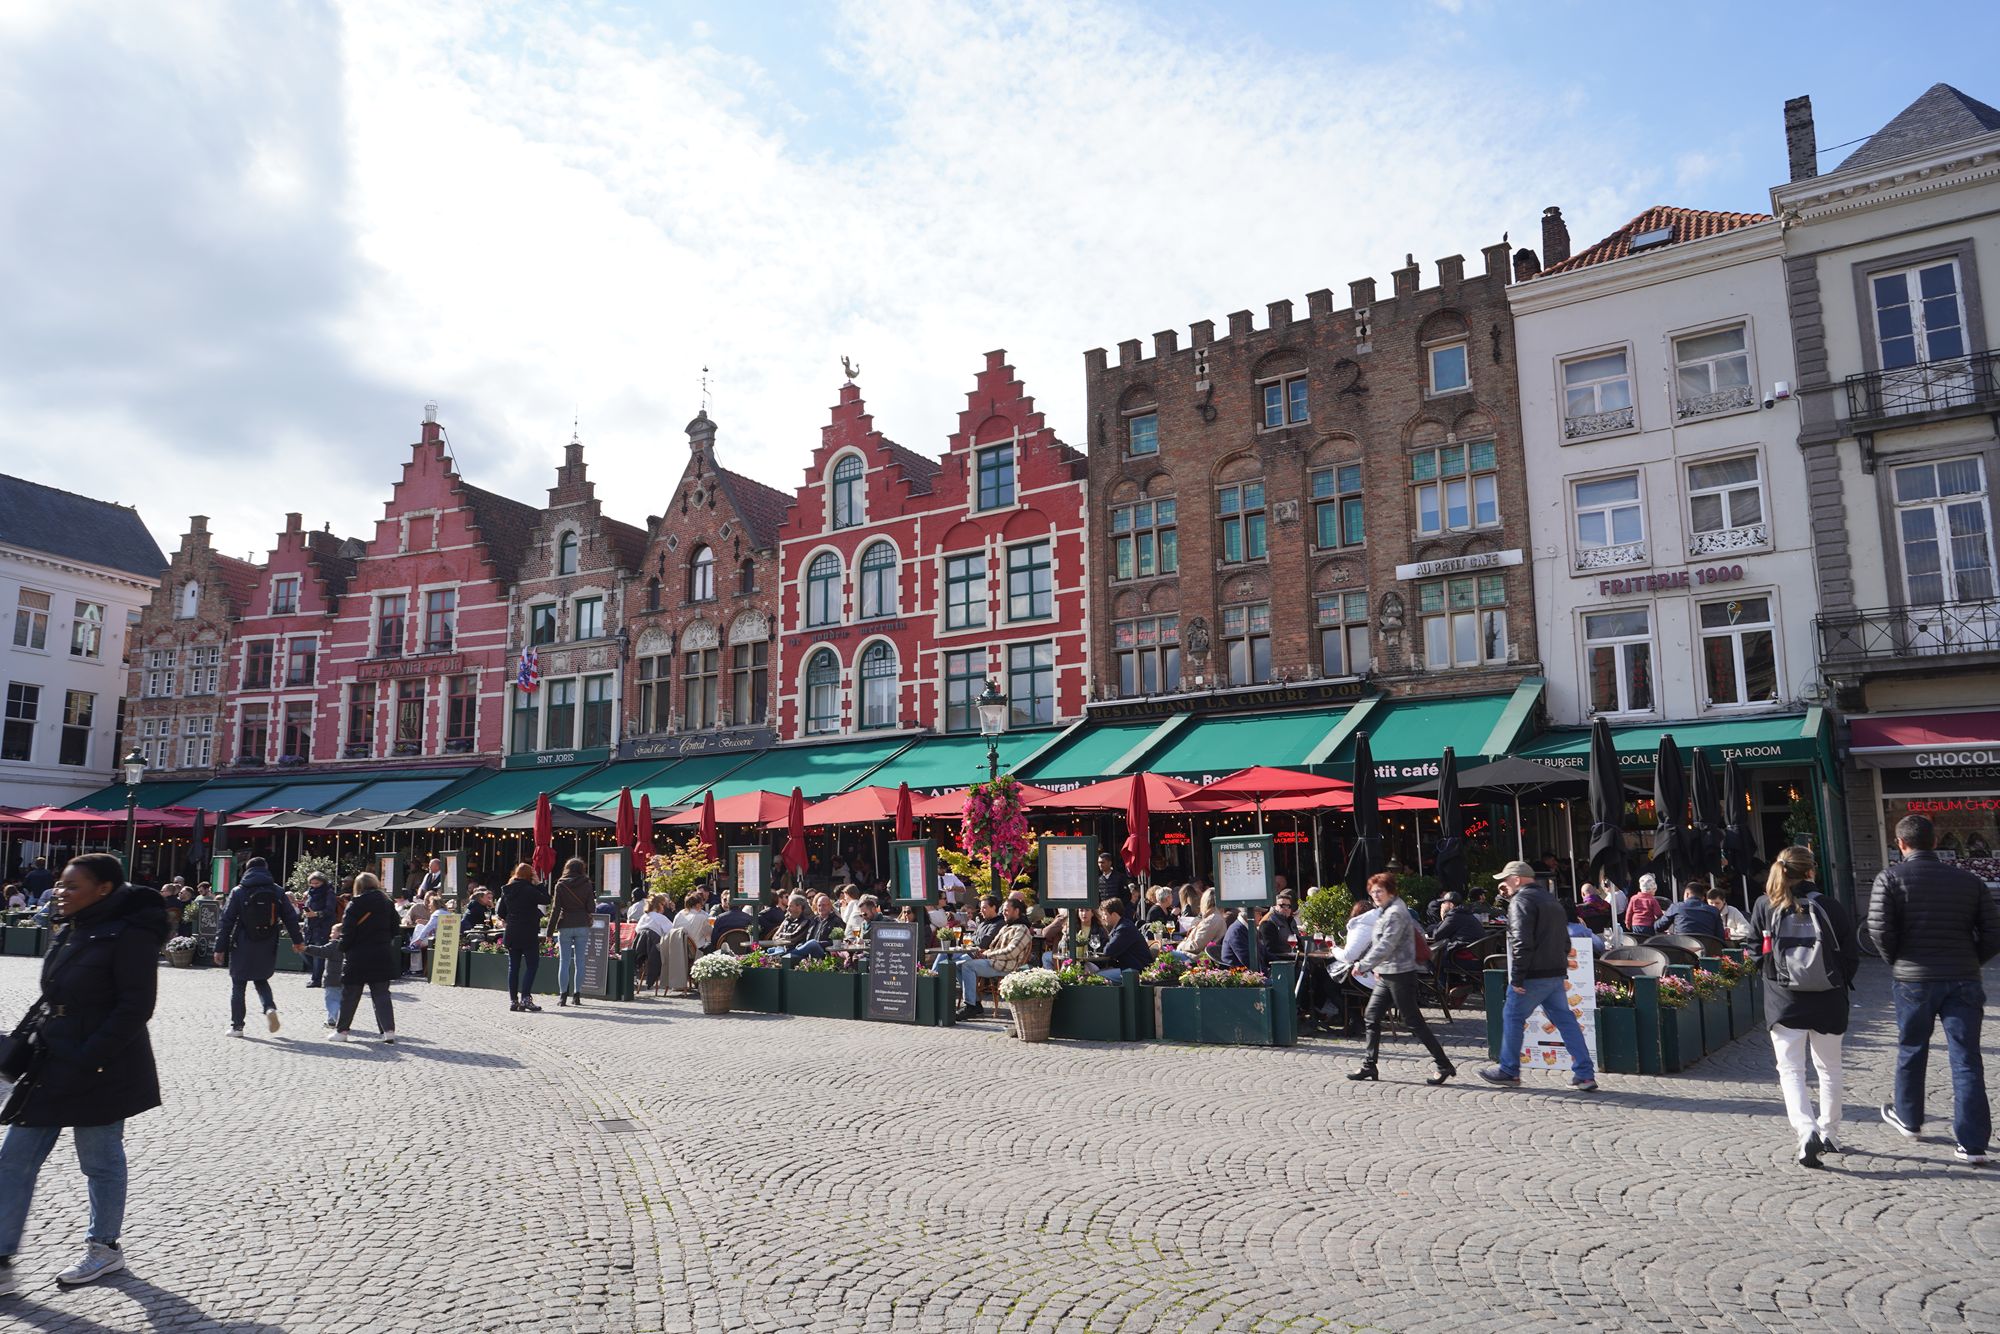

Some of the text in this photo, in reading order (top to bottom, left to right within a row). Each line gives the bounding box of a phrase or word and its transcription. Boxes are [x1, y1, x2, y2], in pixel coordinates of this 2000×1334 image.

[1416, 563, 1431, 576] AU
[1434, 558, 1466, 573] PETIT
[1600, 565, 1744, 596] FRITERIE 1900
[1092, 700, 1196, 719] RESTAURANT
[1207, 694, 1229, 709] LA
[679, 738, 707, 754] Central
[1721, 746, 1781, 759] TEA ROOM
[536, 753, 575, 764] SINT JORIS
[1544, 758, 1584, 768] BURGER
[1402, 763, 1439, 777] café
[1909, 768, 1984, 779] CHOCOLATE
[1907, 801, 1963, 811] BELGIUM
[1465, 820, 1488, 837] PIZZA
